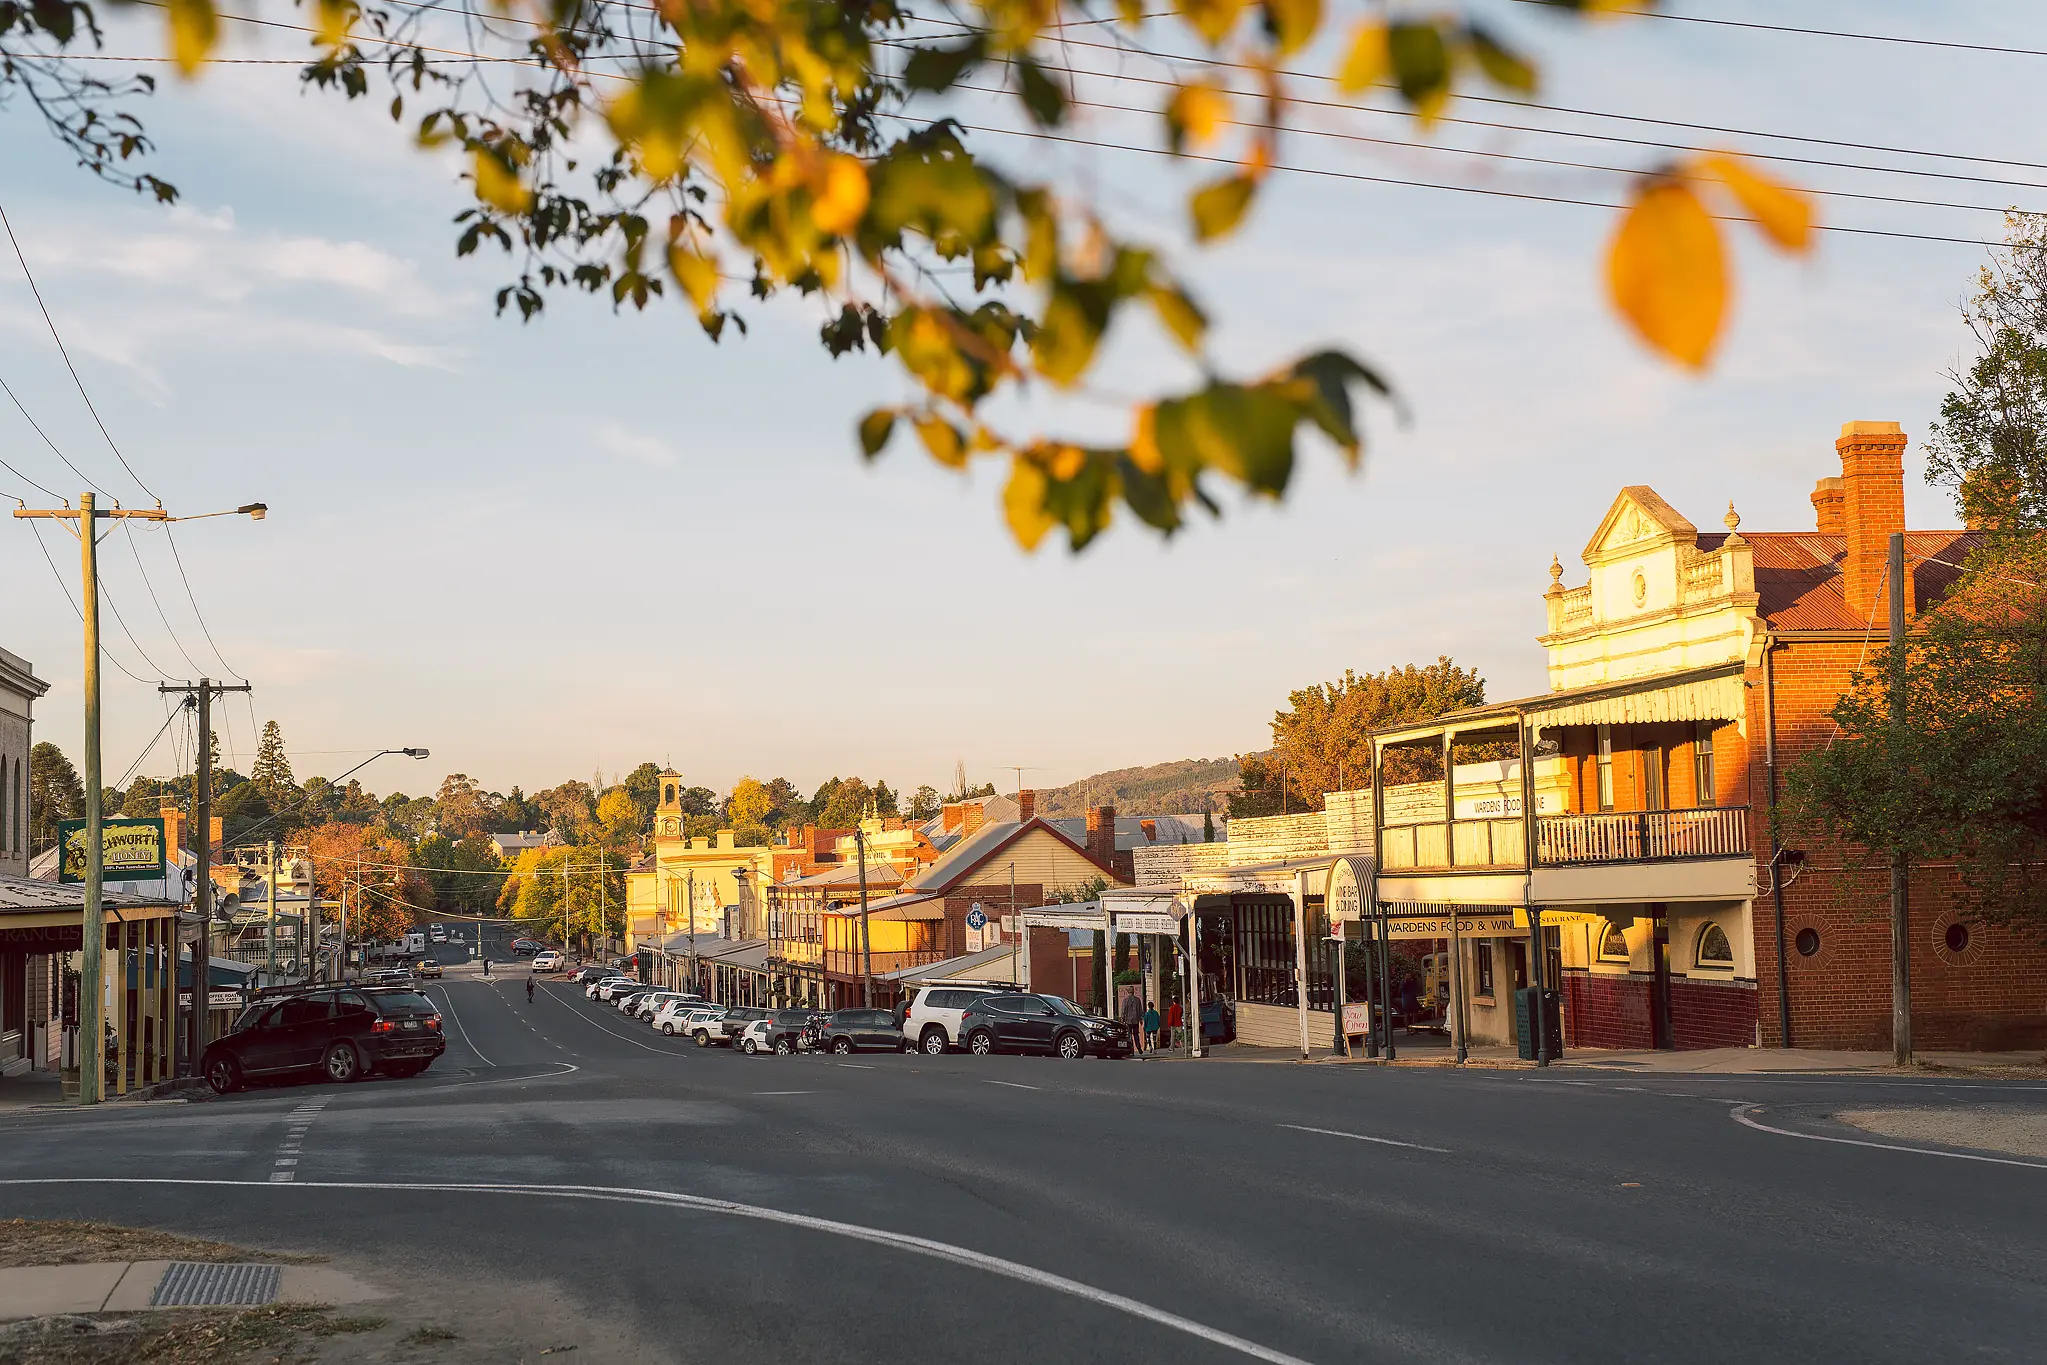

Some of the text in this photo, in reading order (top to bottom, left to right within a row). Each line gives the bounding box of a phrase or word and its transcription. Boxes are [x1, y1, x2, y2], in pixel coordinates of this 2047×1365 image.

[1474, 800, 1500, 813] WARDENS
[1503, 798, 1521, 811] FOOD
[102, 834, 159, 851] CHWORTH
[113, 851, 148, 861] HONEY
[1347, 885, 1358, 897] BAR
[1336, 900, 1358, 911] & DINING
[1541, 915, 1580, 923] STAURANT
[1387, 921, 1437, 932] WARDENS
[1478, 920, 1486, 931] &
[0, 926, 80, 942] RANCES
[1344, 1010, 1362, 1020] Now
[1345, 1020, 1368, 1031] Open
